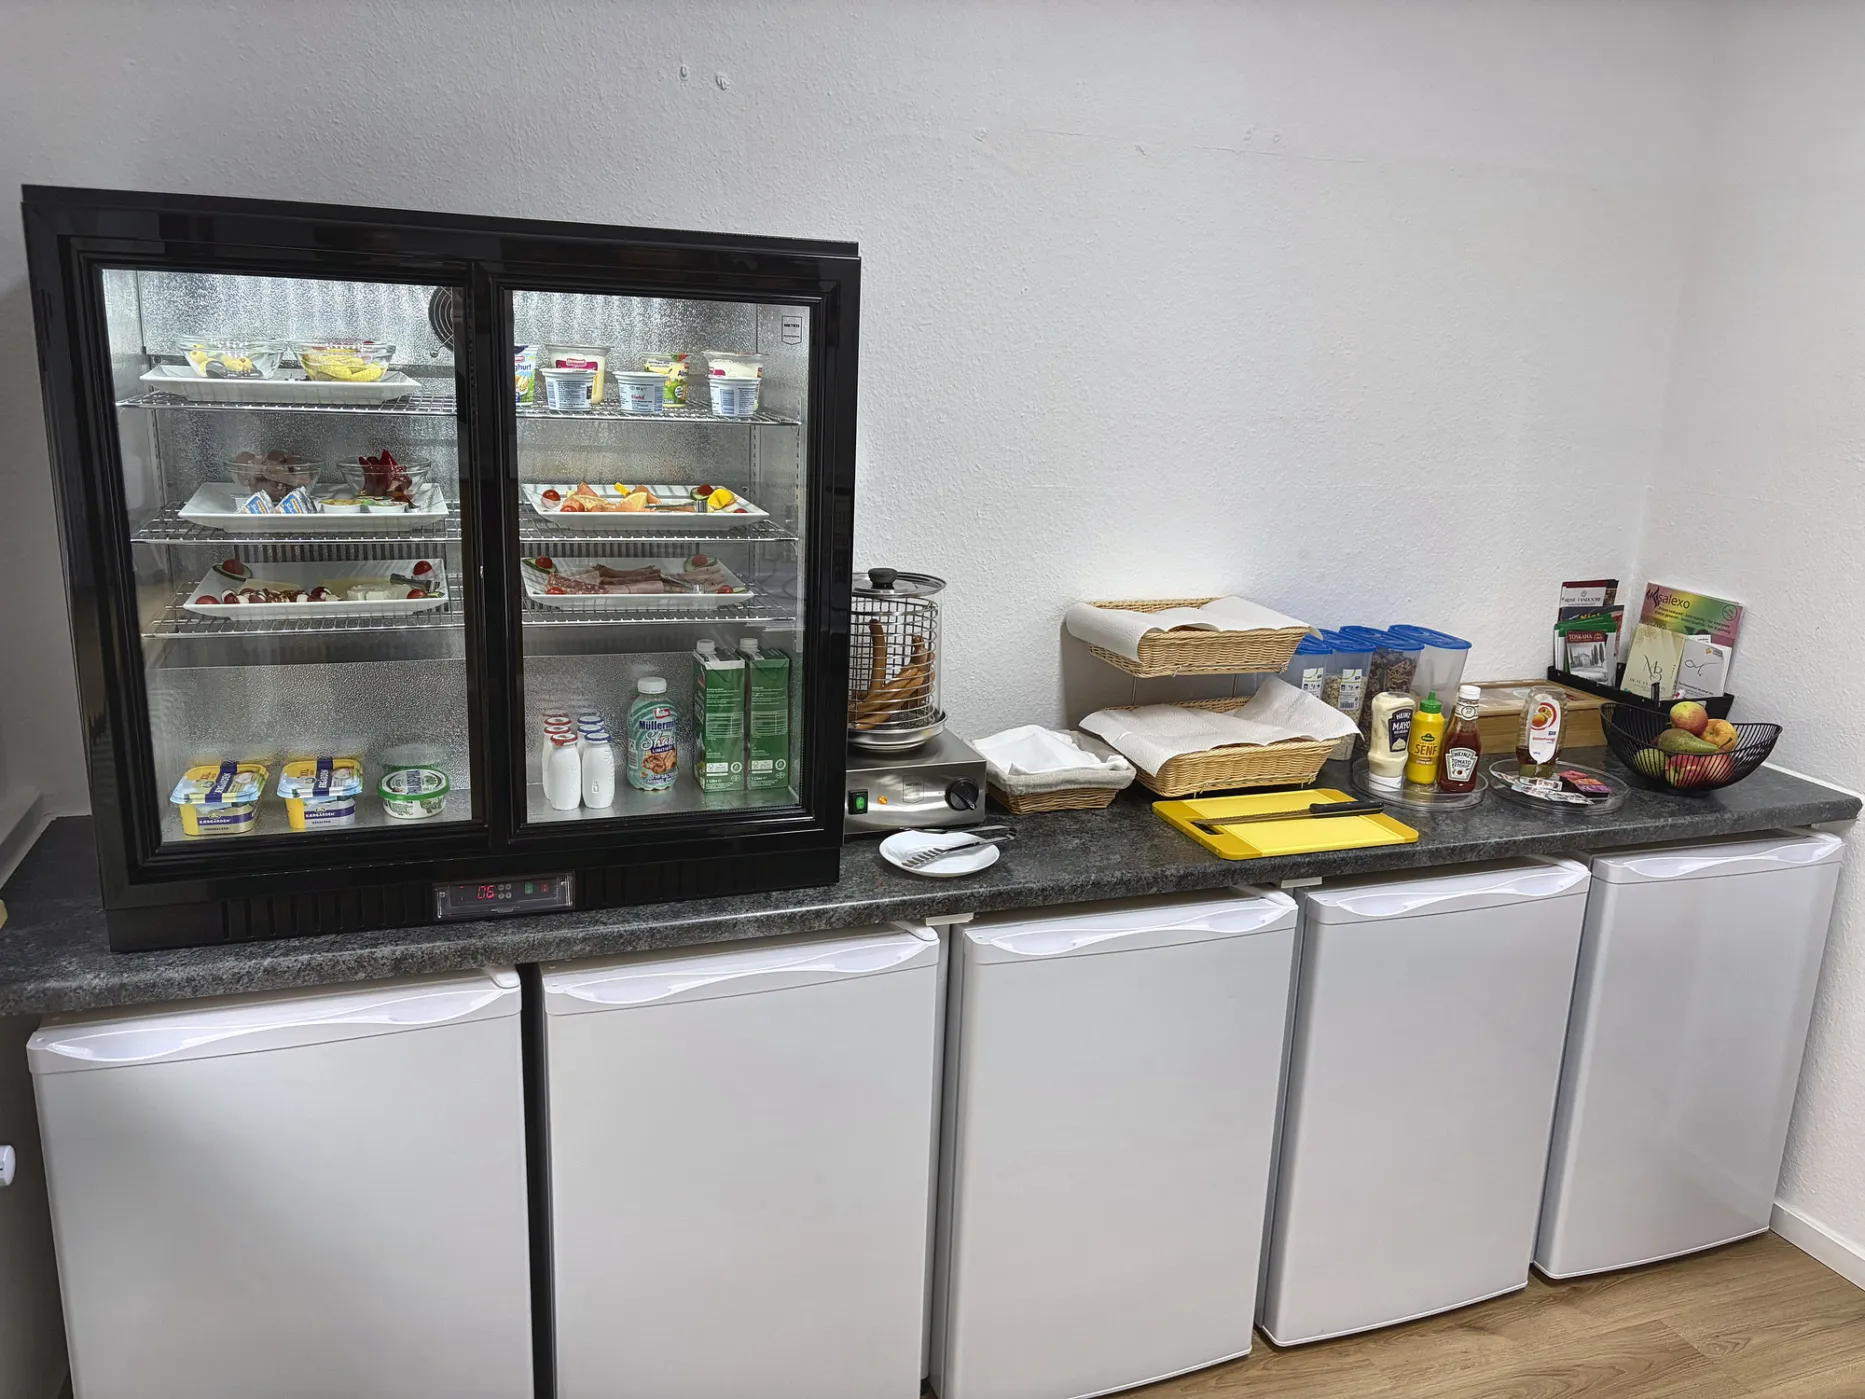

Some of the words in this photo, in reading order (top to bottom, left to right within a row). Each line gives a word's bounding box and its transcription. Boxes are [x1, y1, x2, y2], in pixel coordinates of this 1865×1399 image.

[514, 363, 532, 372] ghurt
[1658, 593, 1691, 610] salexo
[1392, 720, 1411, 731] MAYO
[1415, 744, 1438, 756] SENF
